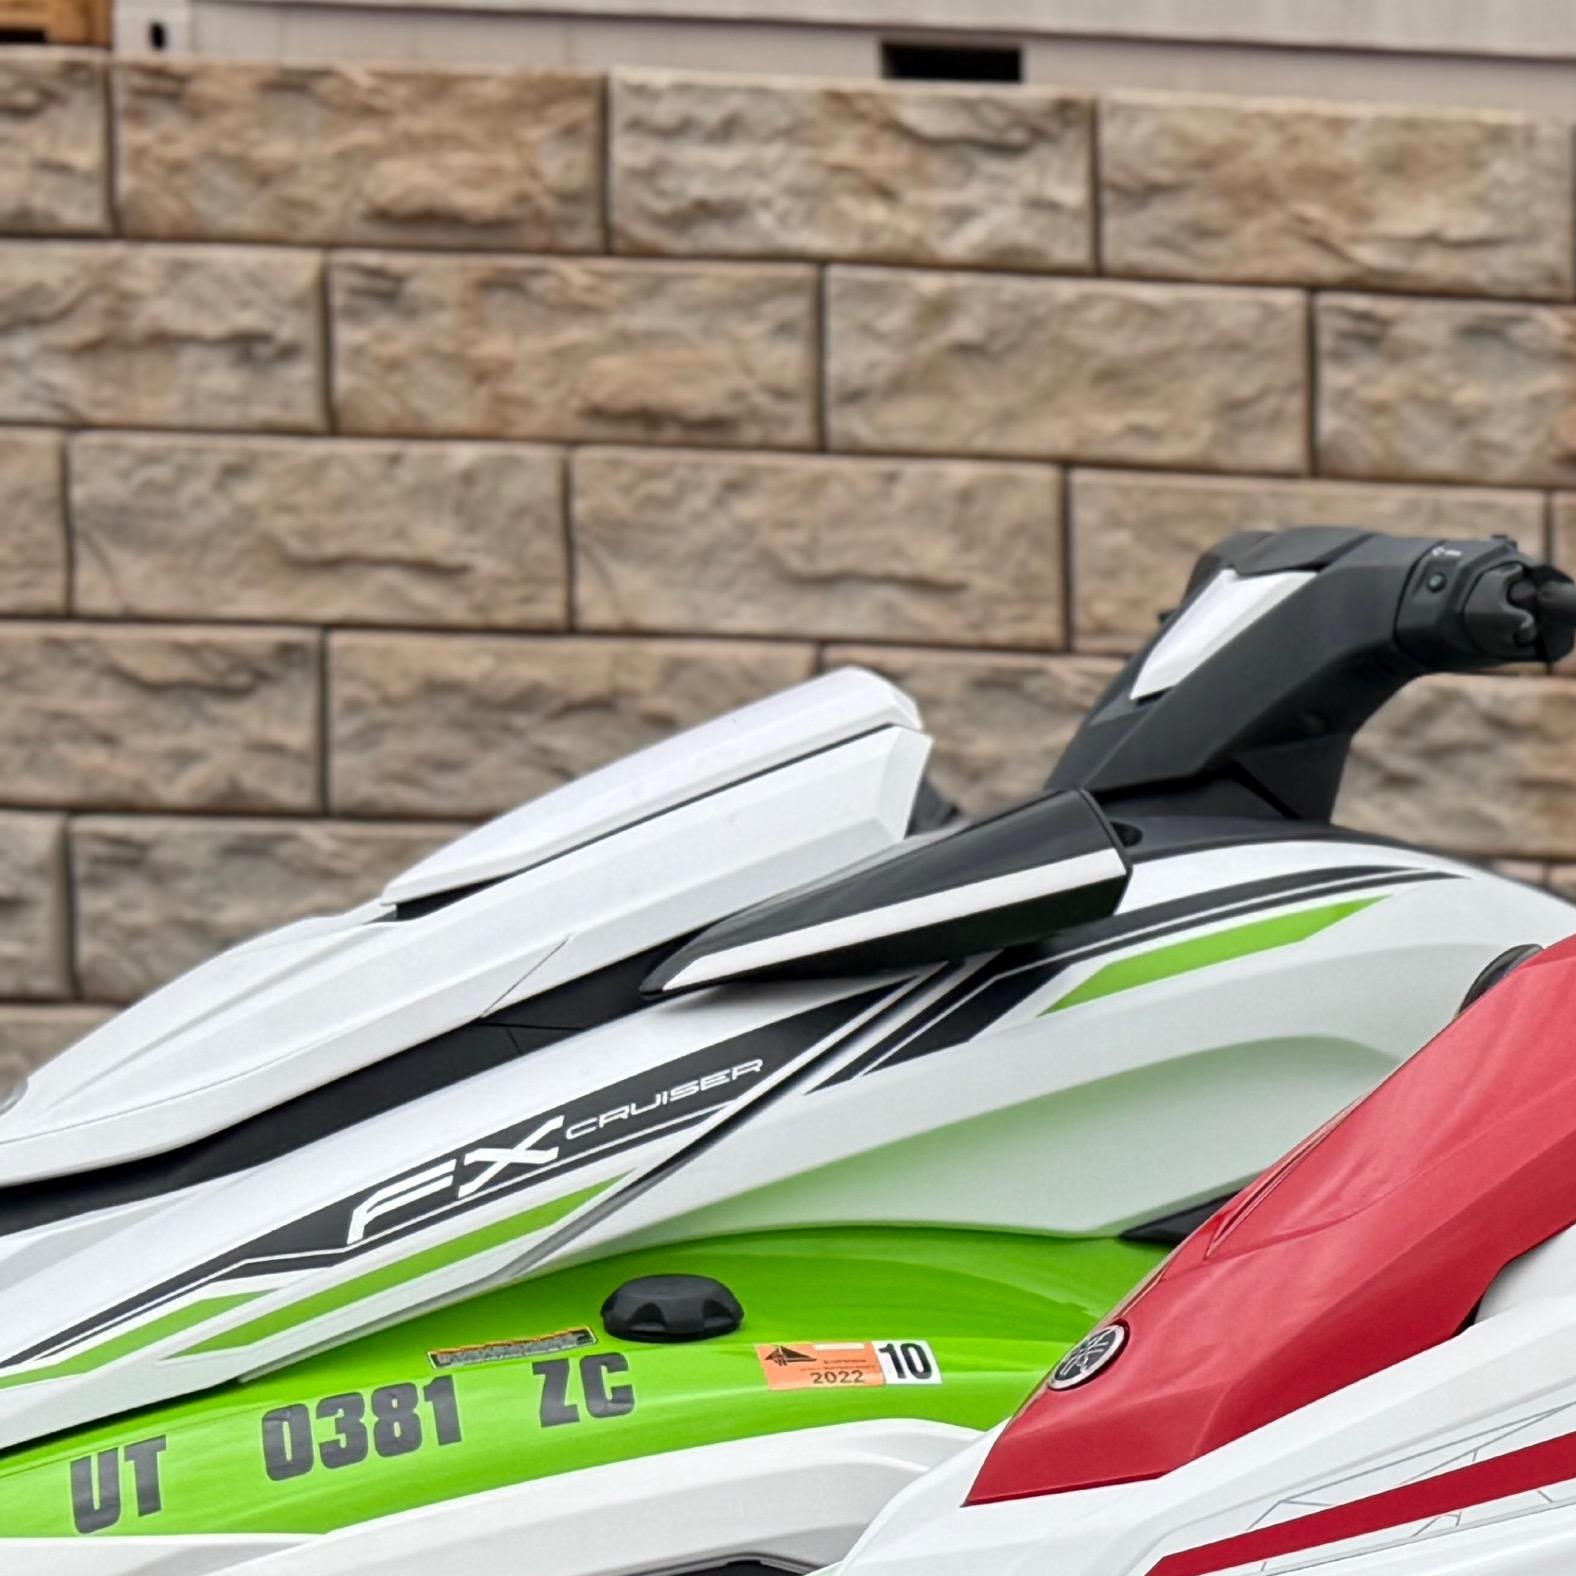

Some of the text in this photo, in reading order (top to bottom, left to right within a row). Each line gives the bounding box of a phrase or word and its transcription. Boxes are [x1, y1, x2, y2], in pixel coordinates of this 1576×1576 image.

[346, 1058, 764, 1245] FX CRUISER
[810, 1370, 865, 1384] 2022
[878, 1343, 931, 1380] 10
[71, 1352, 636, 1534] UT 0381 ZC
